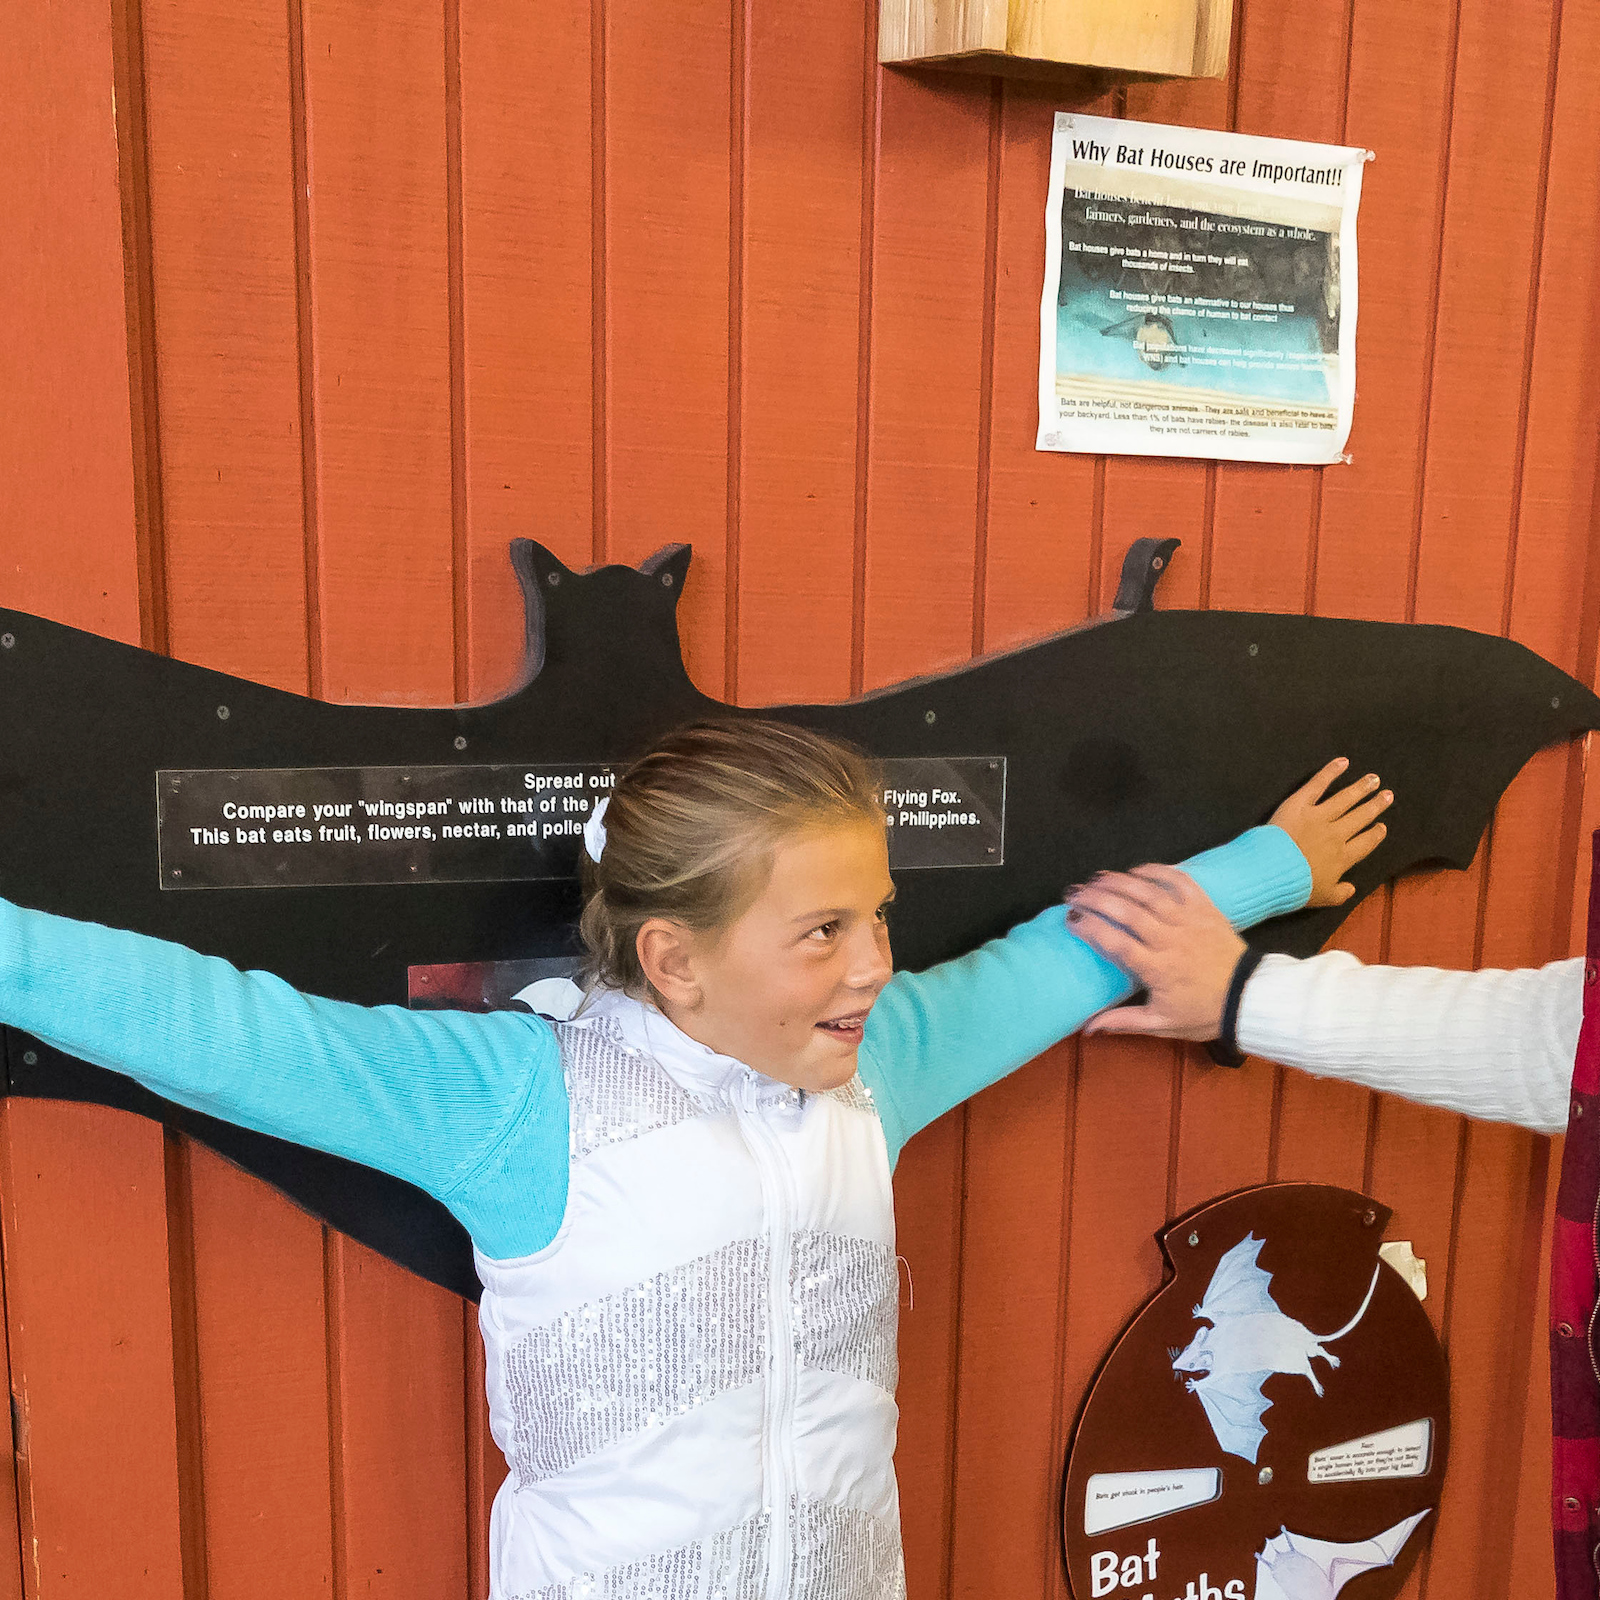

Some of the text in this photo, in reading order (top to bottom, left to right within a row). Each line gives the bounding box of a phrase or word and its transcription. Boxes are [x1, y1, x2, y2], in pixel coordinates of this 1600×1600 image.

[1072, 140, 1342, 186] Why Bat Houses are Important!!
[1085, 206, 1316, 240] farmers, gardeners, and the ecosystem as a whole.
[1068, 240, 1082, 252] Bat
[1082, 242, 1109, 255] houses
[1109, 246, 1125, 257] give
[1125, 247, 1141, 258] bats
[1148, 248, 1169, 260] home
[1169, 251, 1183, 261] and
[1183, 251, 1192, 261] in
[1192, 252, 1207, 263] turn
[1207, 254, 1222, 266] they
[1223, 255, 1237, 266] will
[1121, 258, 1159, 271] thousands
[1159, 261, 1168, 271] of
[1109, 289, 1122, 300] Bat
[1122, 290, 1150, 302] houses
[1150, 294, 1166, 304] give
[1167, 294, 1182, 304] bats
[1194, 297, 1230, 308] alternative
[1252, 300, 1277, 312] houses
[1126, 304, 1158, 316] reducing
[1061, 398, 1077, 407] Bats
[1079, 400, 1090, 408] are
[1133, 402, 1170, 413] dangerous
[1059, 410, 1075, 420] your
[1077, 410, 1111, 422] backyard.
[1113, 412, 1130, 421] Less
[1131, 412, 1148, 421] than
[1161, 414, 1170, 422] of
[1171, 415, 1186, 424] bats
[1187, 415, 1204, 425] have
[1149, 424, 1164, 435] they
[1166, 426, 1178, 434] are
[1179, 426, 1191, 435] not
[1218, 427, 1227, 436] of
[524, 773, 616, 793] Spread out
[222, 802, 306, 823] Compare
[312, 804, 352, 822] your
[358, 798, 452, 820] "wingspan"
[458, 797, 495, 815] with
[500, 797, 533, 814] that
[539, 797, 557, 813] of
[562, 796, 589, 812] the
[883, 789, 928, 808] Flying
[931, 788, 962, 804] Fox.
[190, 827, 230, 845] This
[236, 826, 267, 844] bat
[272, 826, 313, 843] eats
[319, 824, 362, 843] fruit,
[367, 823, 437, 841] flowers,
[442, 822, 501, 840] nectar,
[506, 820, 538, 837] and
[899, 810, 981, 829] Philippines.
[1095, 1491, 1109, 1500] Bats
[1110, 1490, 1121, 1500] get
[1122, 1488, 1137, 1497] stuck
[1147, 1484, 1170, 1495] people's
[1091, 1538, 1161, 1598] Bat
